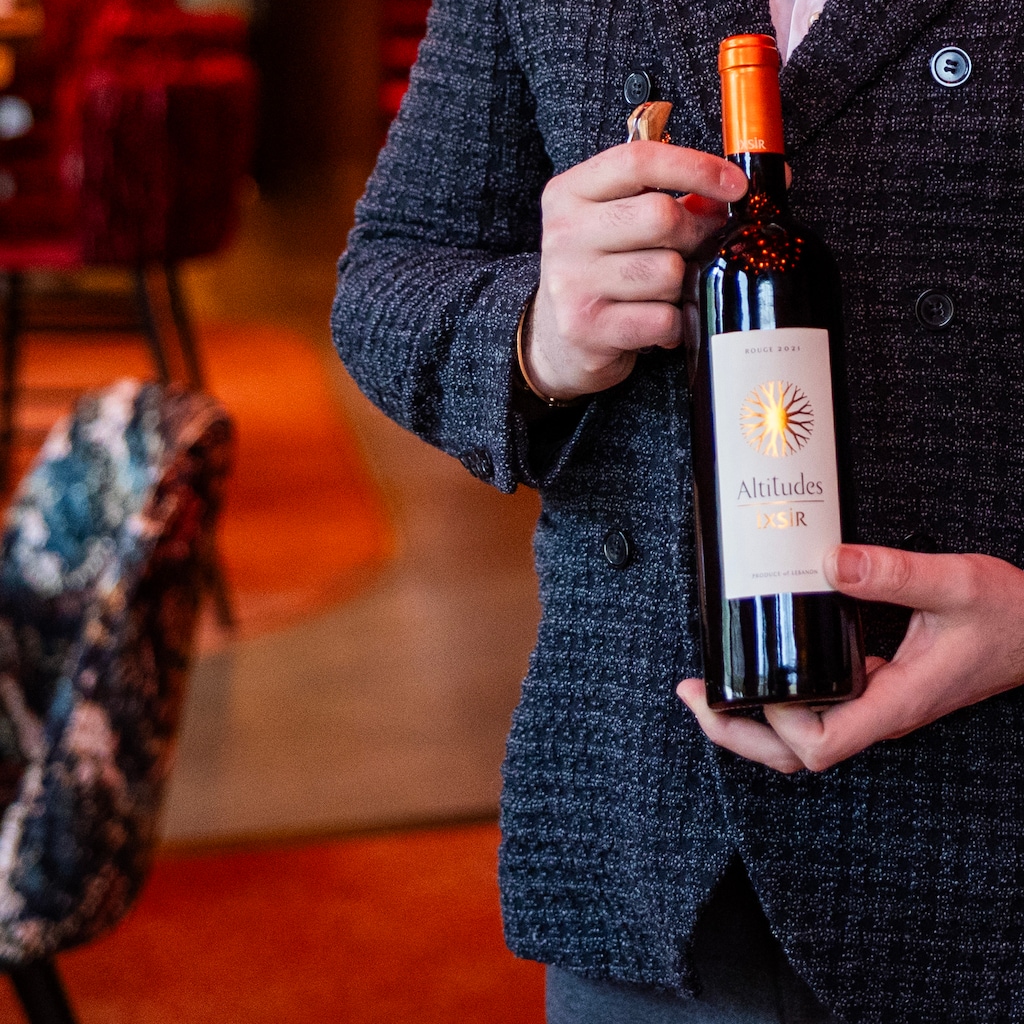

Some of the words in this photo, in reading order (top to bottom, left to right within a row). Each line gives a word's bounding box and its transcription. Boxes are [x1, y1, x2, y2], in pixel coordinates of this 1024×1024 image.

[744, 346, 773, 354] ROUGE
[737, 472, 823, 500] Altitudes
[752, 571, 781, 579] PRODUCE
